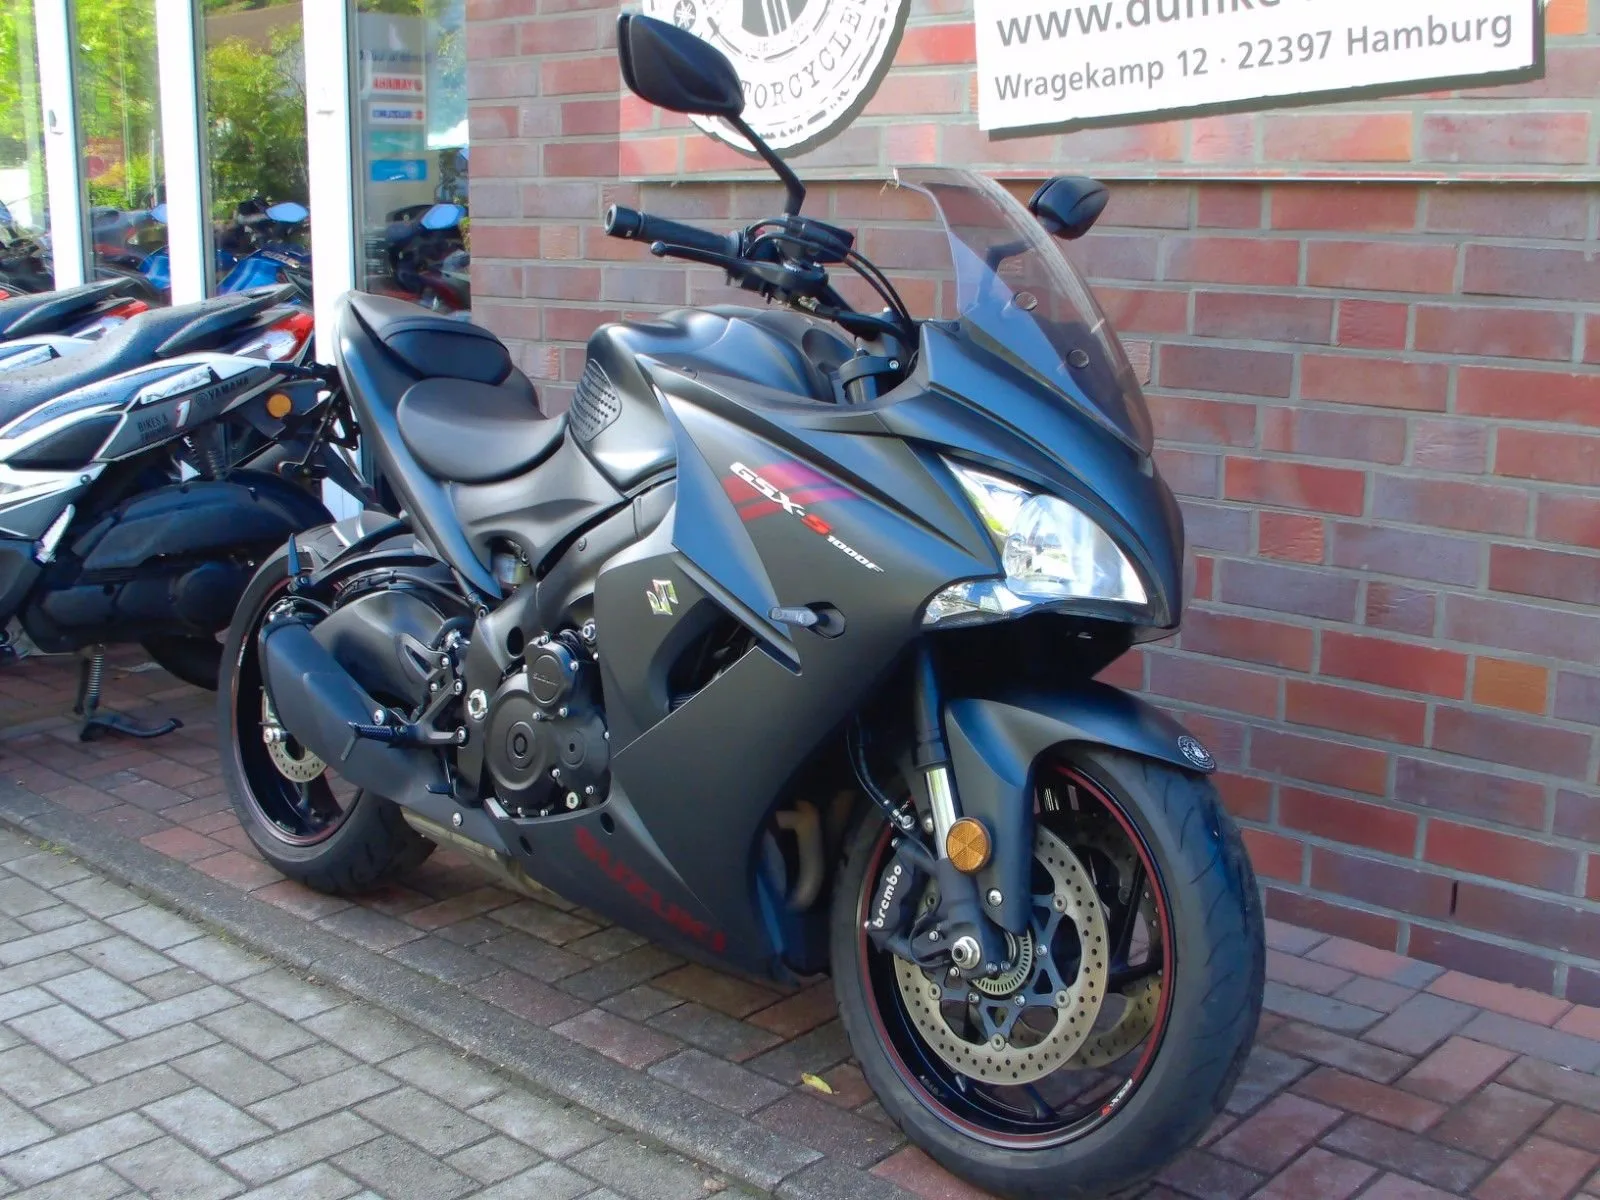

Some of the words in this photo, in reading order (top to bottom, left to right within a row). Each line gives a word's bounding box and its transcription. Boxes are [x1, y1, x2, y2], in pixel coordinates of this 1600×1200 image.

[996, 0, 1281, 47] www.dum
[994, 62, 1164, 101] Wragekamp
[1177, 47, 1209, 77] 12
[1238, 30, 1332, 70] 22397
[1346, 15, 1512, 56] Hamburg
[210, 378, 249, 397] YAMAHA
[872, 864, 903, 928] brembo
